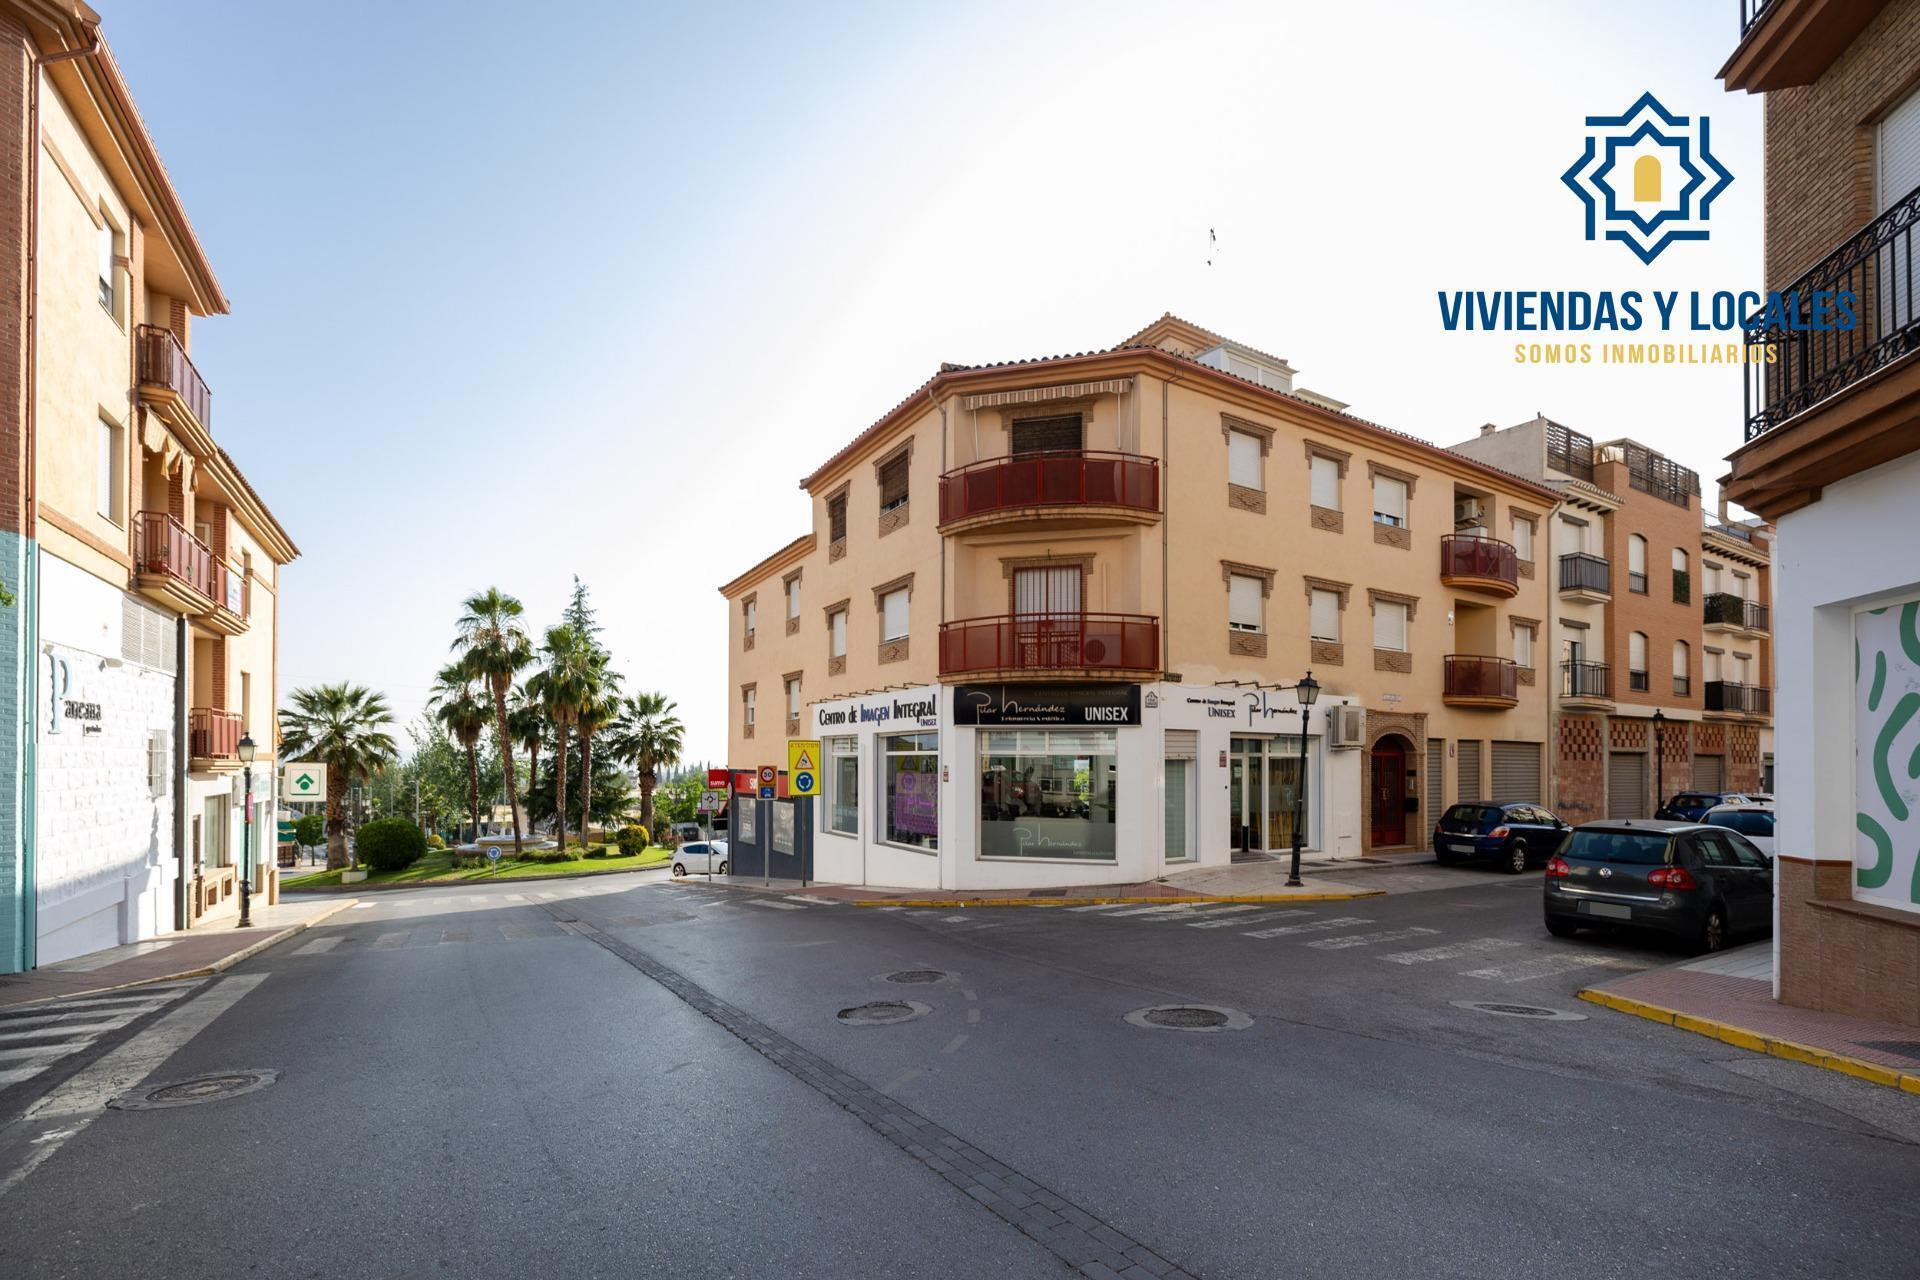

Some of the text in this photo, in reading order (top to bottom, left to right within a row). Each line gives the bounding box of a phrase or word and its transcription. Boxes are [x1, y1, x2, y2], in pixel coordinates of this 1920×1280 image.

[819, 708, 846, 726] CENTRO
[860, 704, 890, 727] IMAGEN
[893, 694, 937, 723] INTEGRAL
[1084, 707, 1129, 721] UNISEX
[1207, 706, 1236, 718] UNISEX
